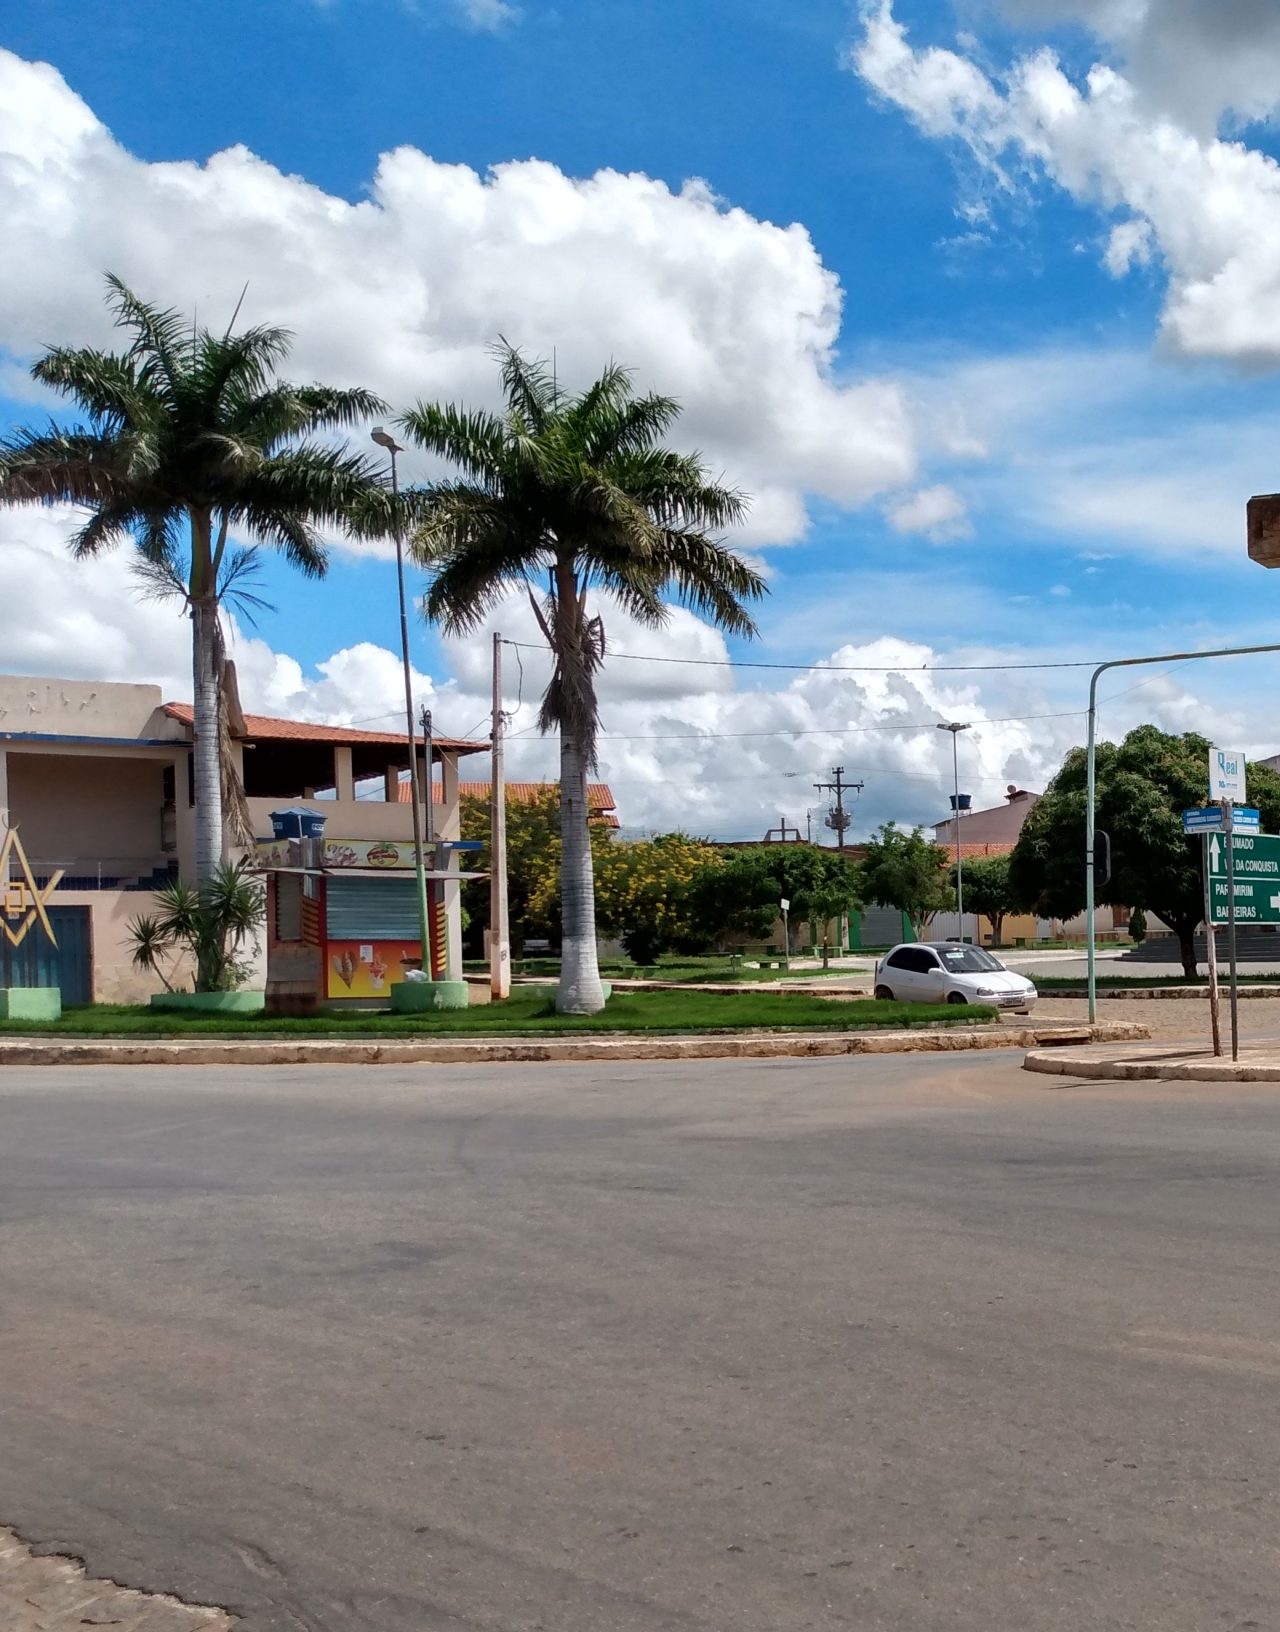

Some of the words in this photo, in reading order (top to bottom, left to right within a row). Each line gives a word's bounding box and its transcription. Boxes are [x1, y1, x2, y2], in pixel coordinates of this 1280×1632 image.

[1218, 752, 1238, 778] Real
[1223, 836, 1254, 850] BUMADO
[1235, 859, 1245, 871] DA
[1245, 860, 1279, 873] CONQUISTA
[1215, 883, 1254, 897] PARMIRIM
